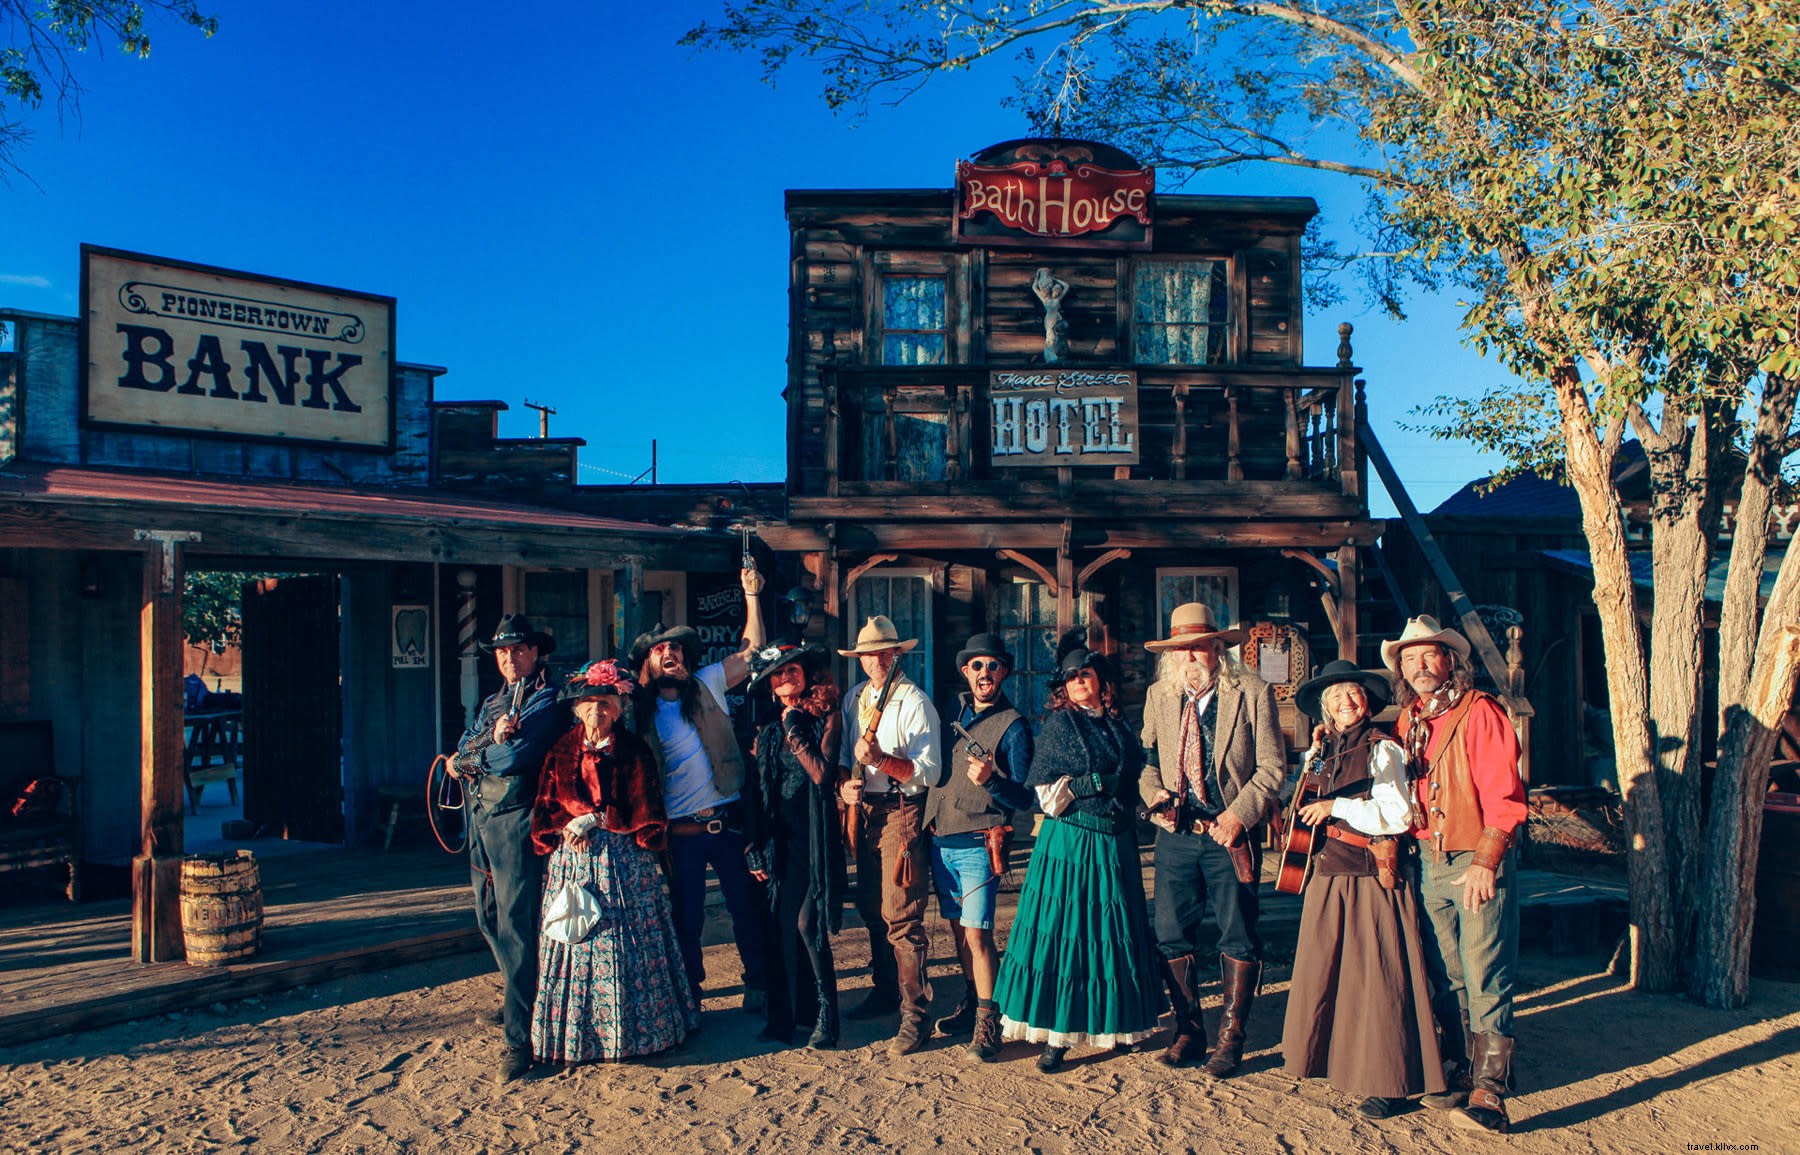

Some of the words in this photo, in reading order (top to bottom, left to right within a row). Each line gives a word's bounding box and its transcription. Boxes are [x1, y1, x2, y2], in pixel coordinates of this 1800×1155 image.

[161, 292, 329, 334] PIONEERTOWN
[116, 322, 362, 413] BANK
[992, 396, 1133, 455] HOTEL
[696, 625, 742, 644] DRY
